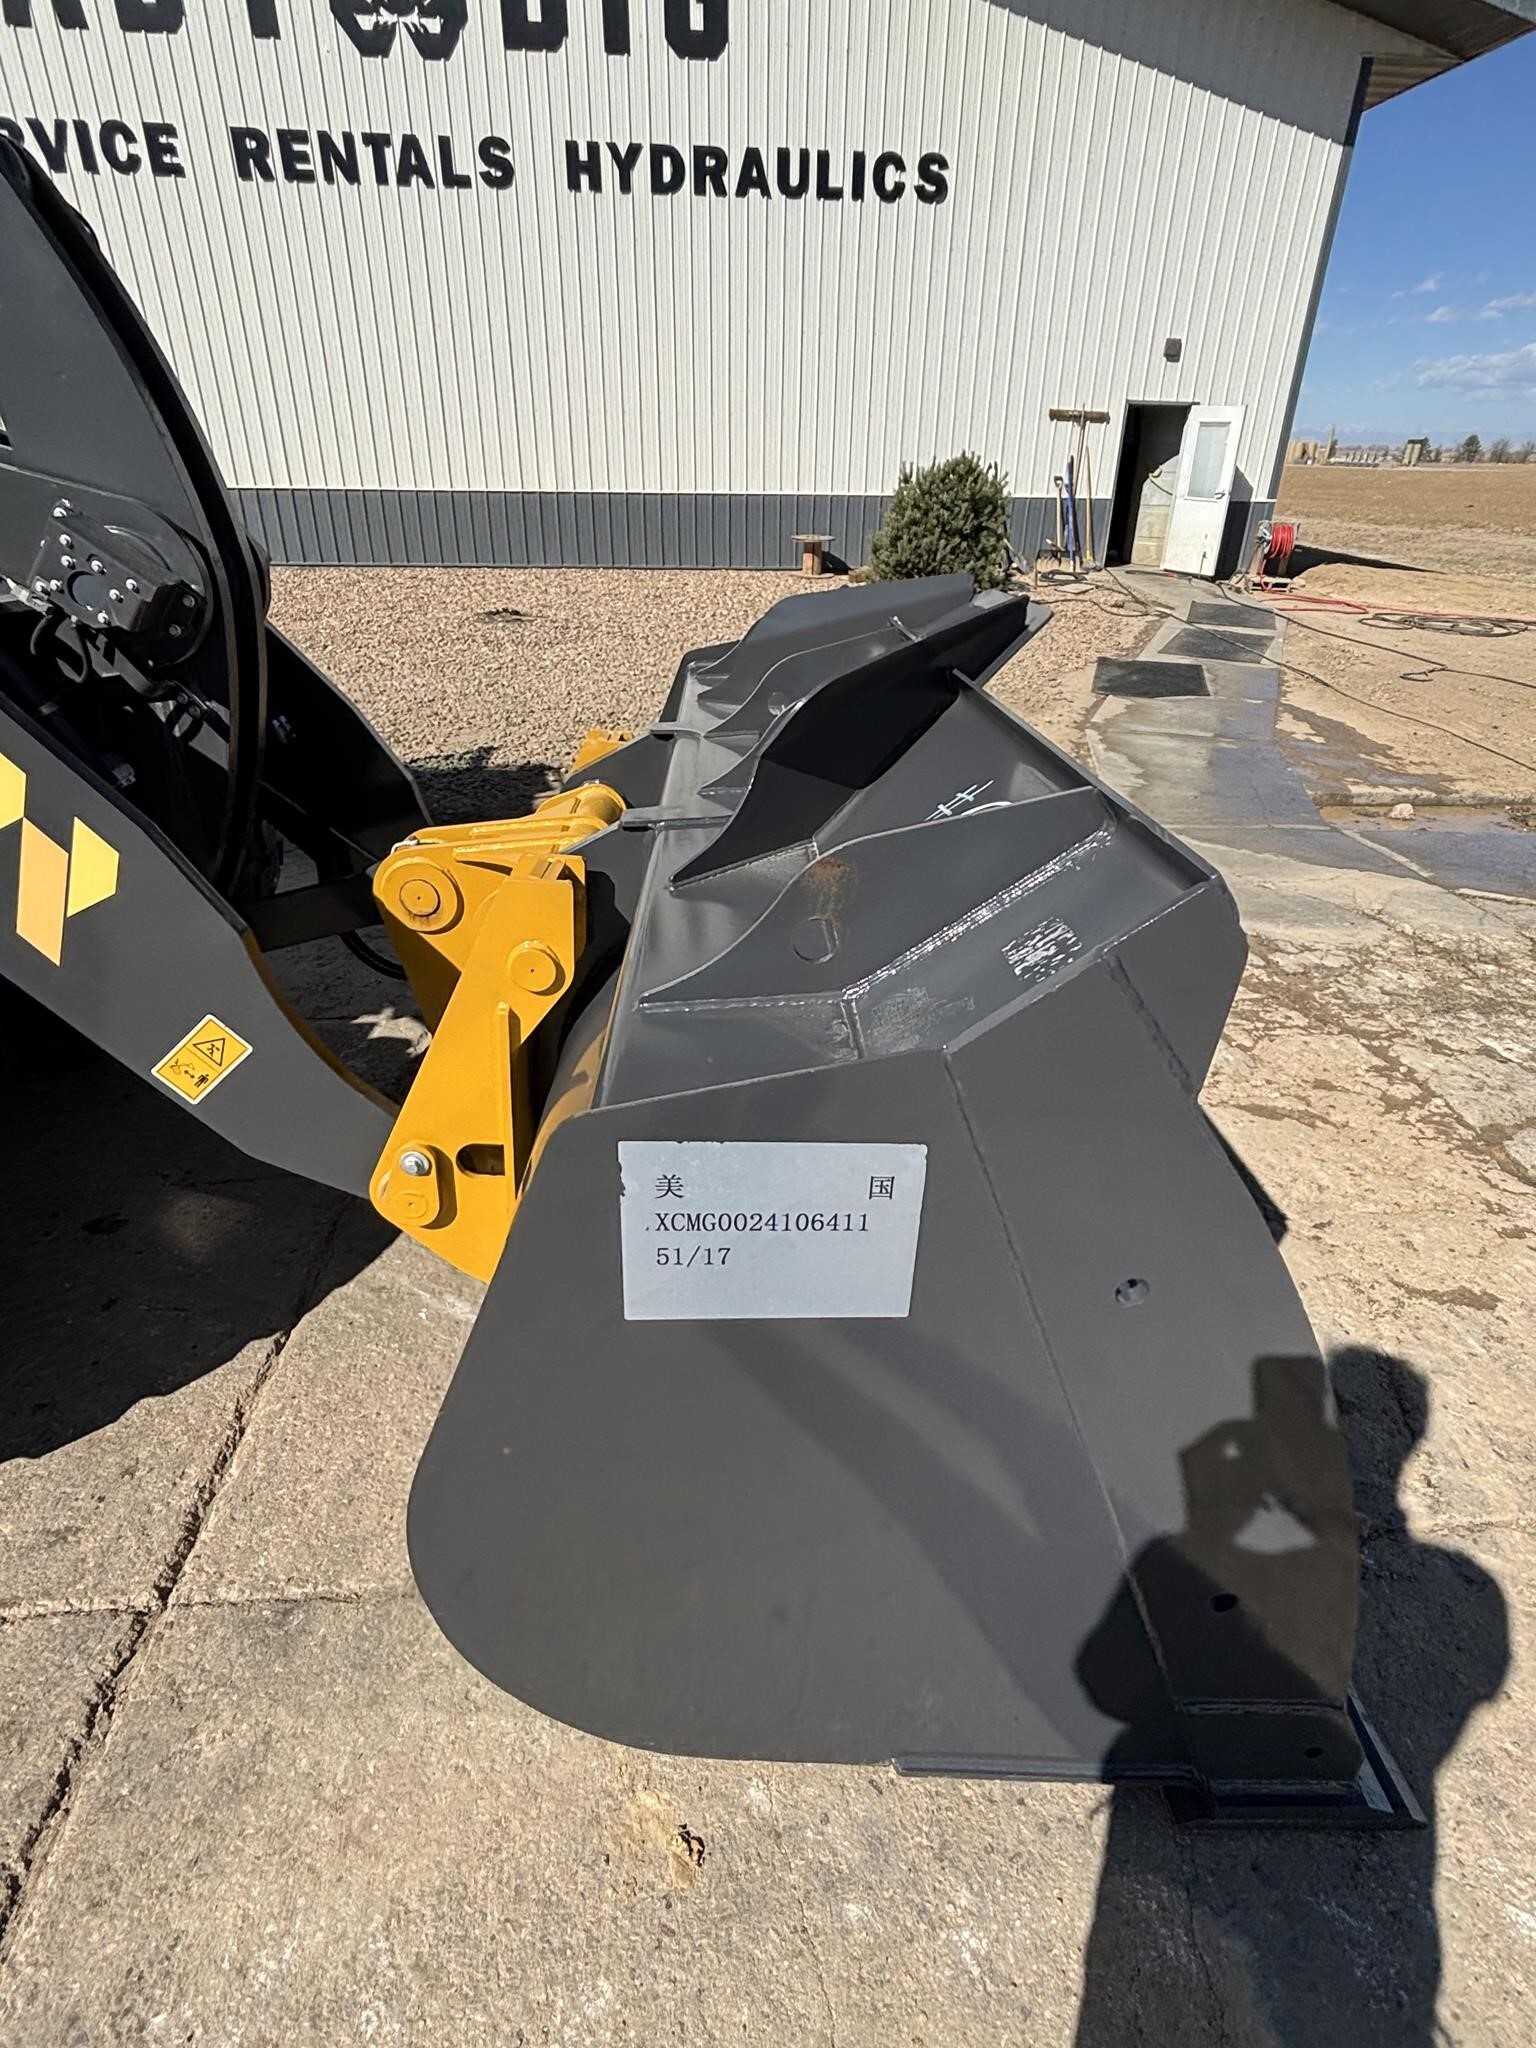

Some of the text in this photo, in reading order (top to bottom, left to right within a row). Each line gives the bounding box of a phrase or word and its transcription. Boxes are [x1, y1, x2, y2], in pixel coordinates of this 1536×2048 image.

[230, 126, 515, 190] RENTALS
[565, 140, 949, 205] HYDRAULICS
[655, 1174, 895, 1200] 美 国
[656, 1245, 731, 1268] 51/17
